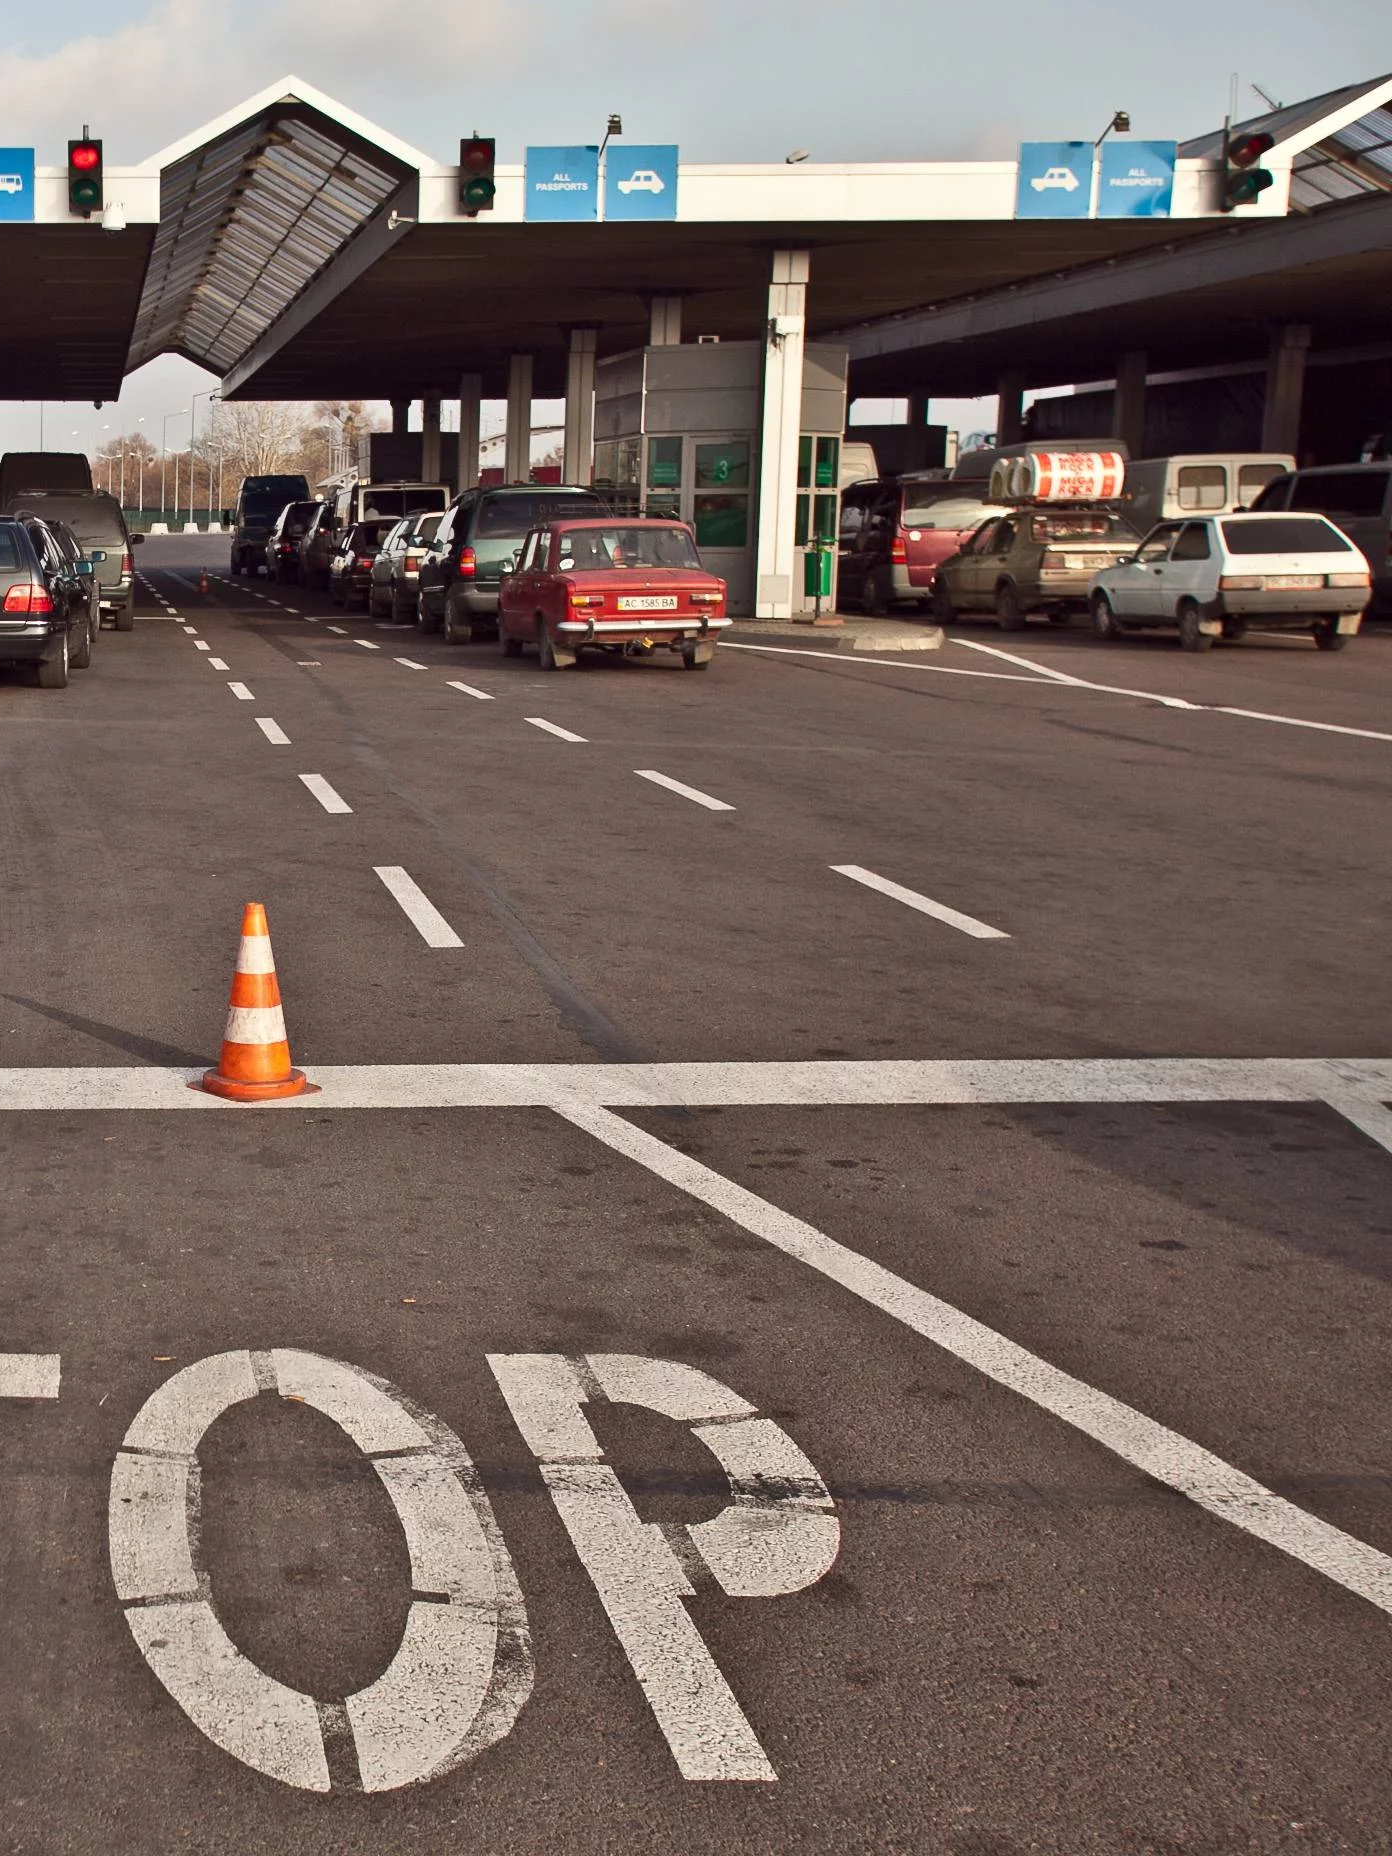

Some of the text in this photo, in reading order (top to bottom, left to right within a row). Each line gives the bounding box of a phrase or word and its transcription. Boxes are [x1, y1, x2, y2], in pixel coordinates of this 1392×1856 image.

[553, 173, 571, 181] ALL
[1128, 168, 1147, 177] ALL
[535, 183, 588, 191] PASSPORTS
[1110, 178, 1164, 187] PASSPORTS
[719, 460, 728, 479] 3
[624, 598, 675, 608] AC 1585 BA
